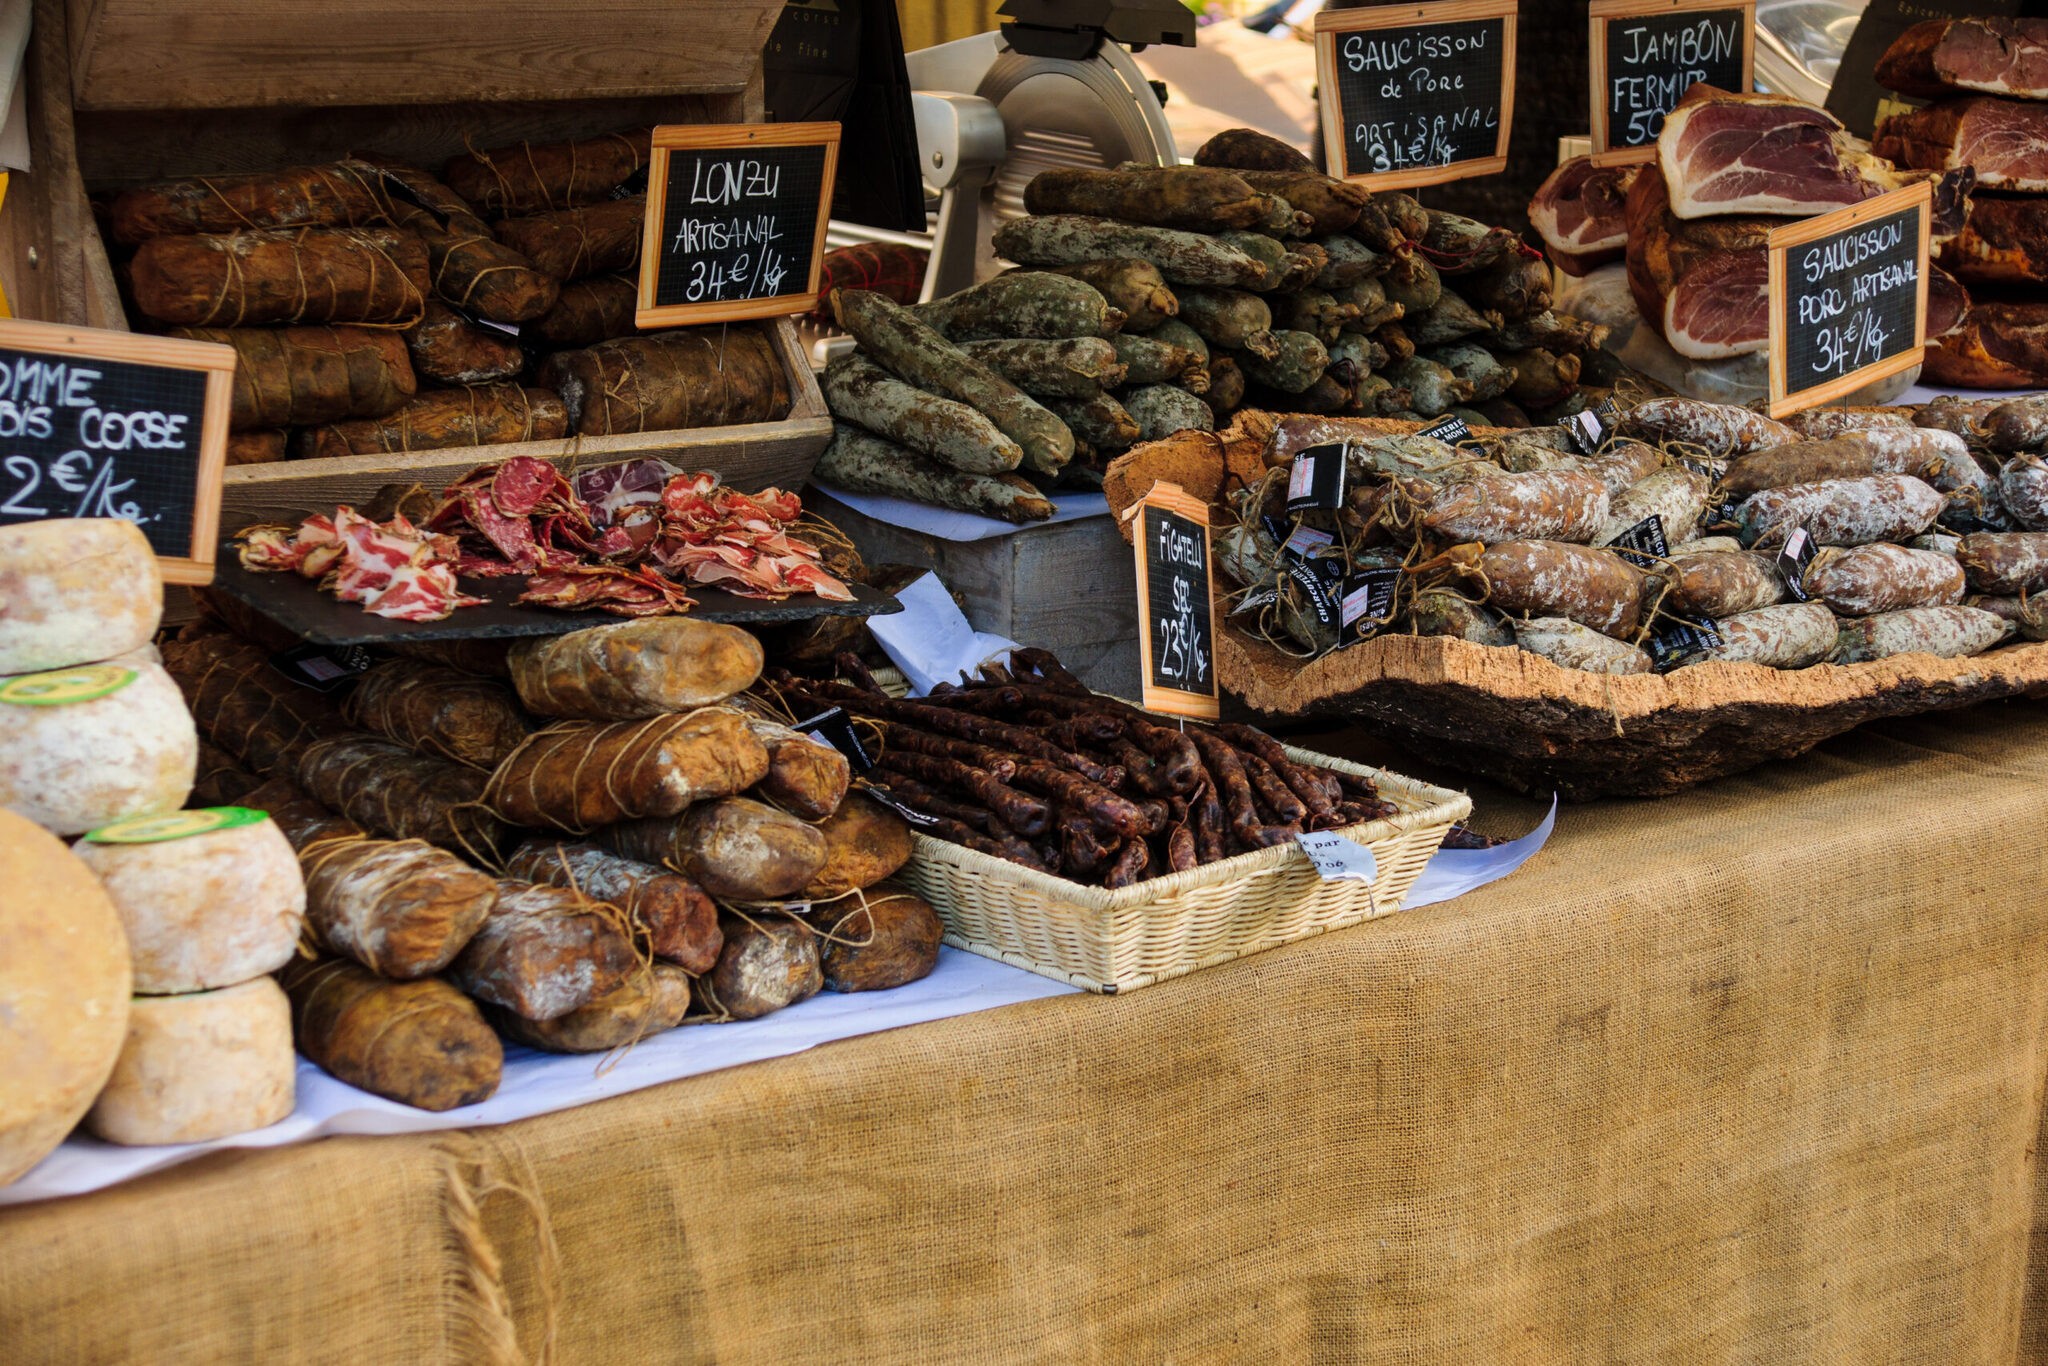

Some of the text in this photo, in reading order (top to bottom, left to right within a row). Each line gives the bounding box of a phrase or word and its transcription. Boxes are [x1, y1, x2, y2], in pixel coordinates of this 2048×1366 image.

[1624, 19, 1736, 65] JAMBON
[1381, 78, 1402, 98] de
[690, 158, 780, 206] LONZU
[1799, 288, 1847, 325] PORC
[80, 406, 188, 450] CORSE
[1173, 575, 1192, 613] SEC
[1289, 566, 1329, 622] CHARCUTERIE
[1315, 840, 1340, 849] par
